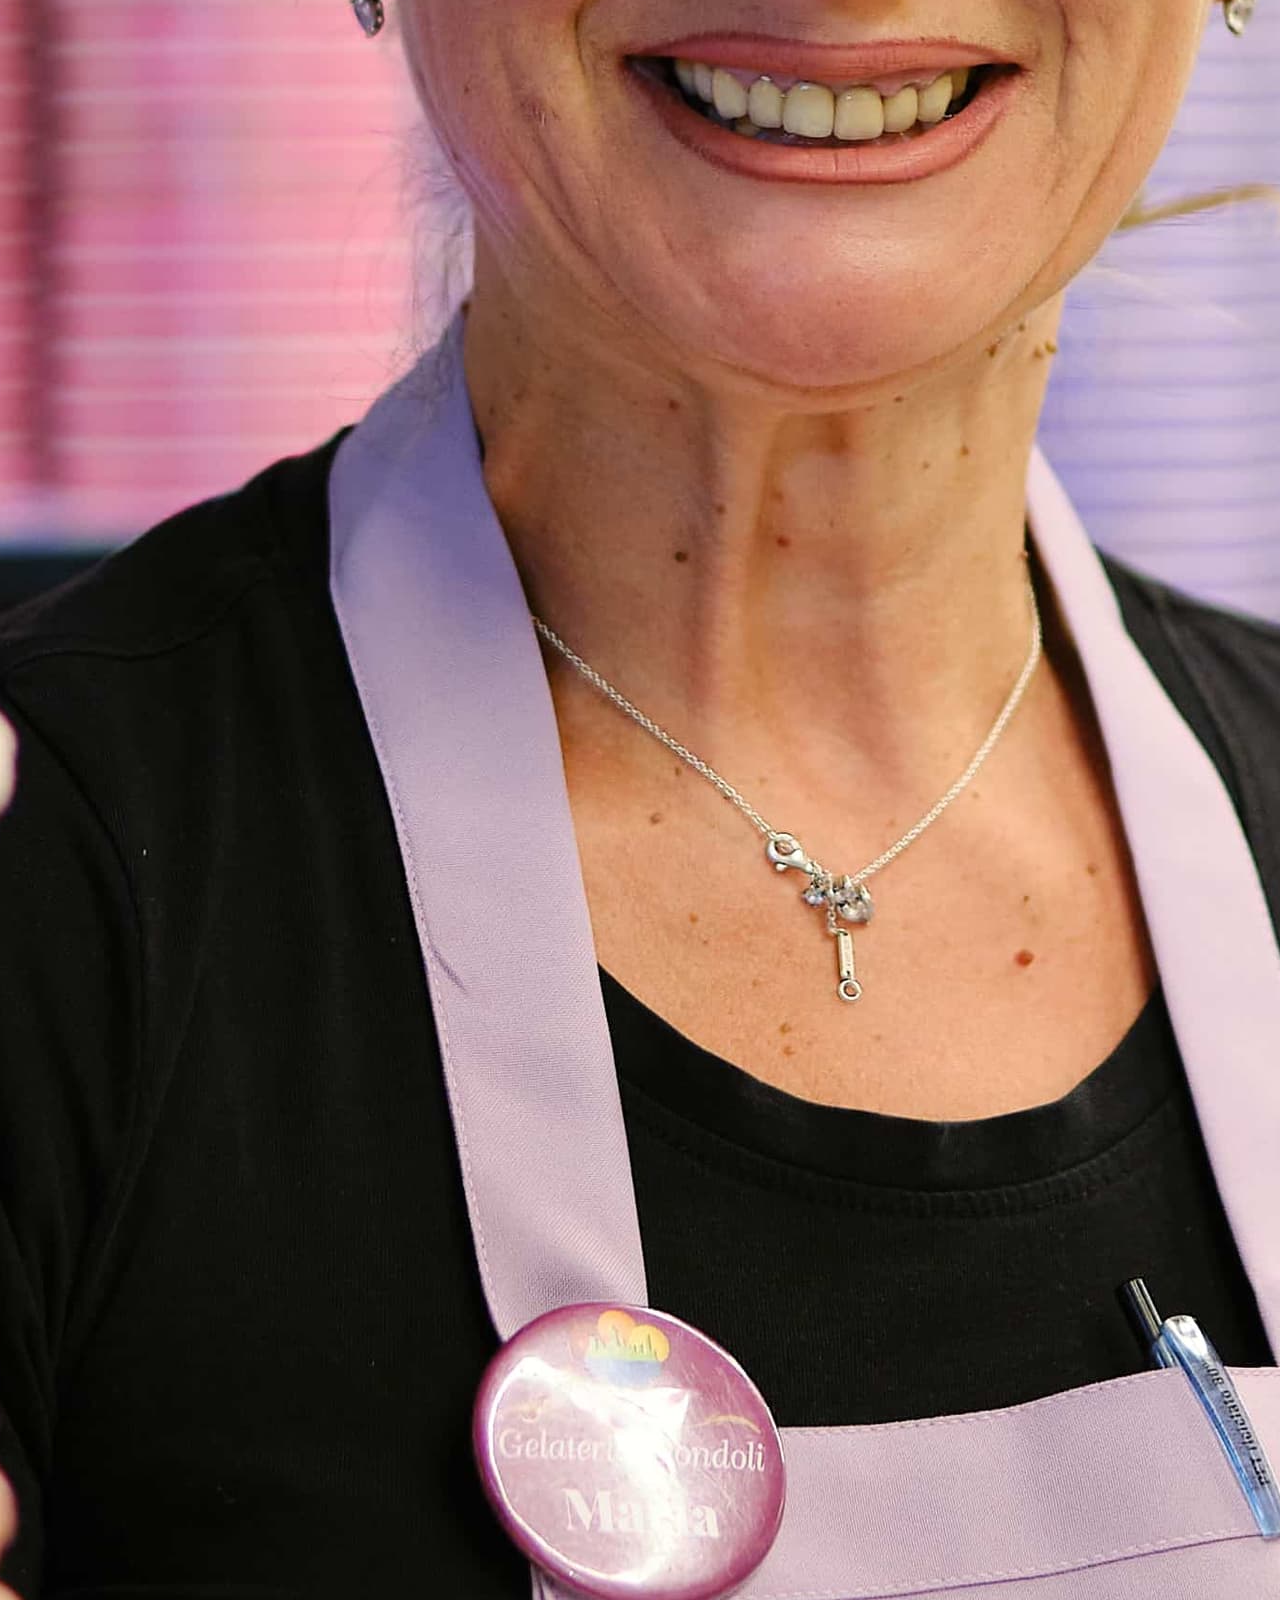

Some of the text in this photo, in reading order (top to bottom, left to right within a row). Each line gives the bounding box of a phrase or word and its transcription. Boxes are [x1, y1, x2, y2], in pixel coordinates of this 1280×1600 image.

[500, 1427, 765, 1472] Gelateri ondoli
[563, 1488, 720, 1538] Maia
